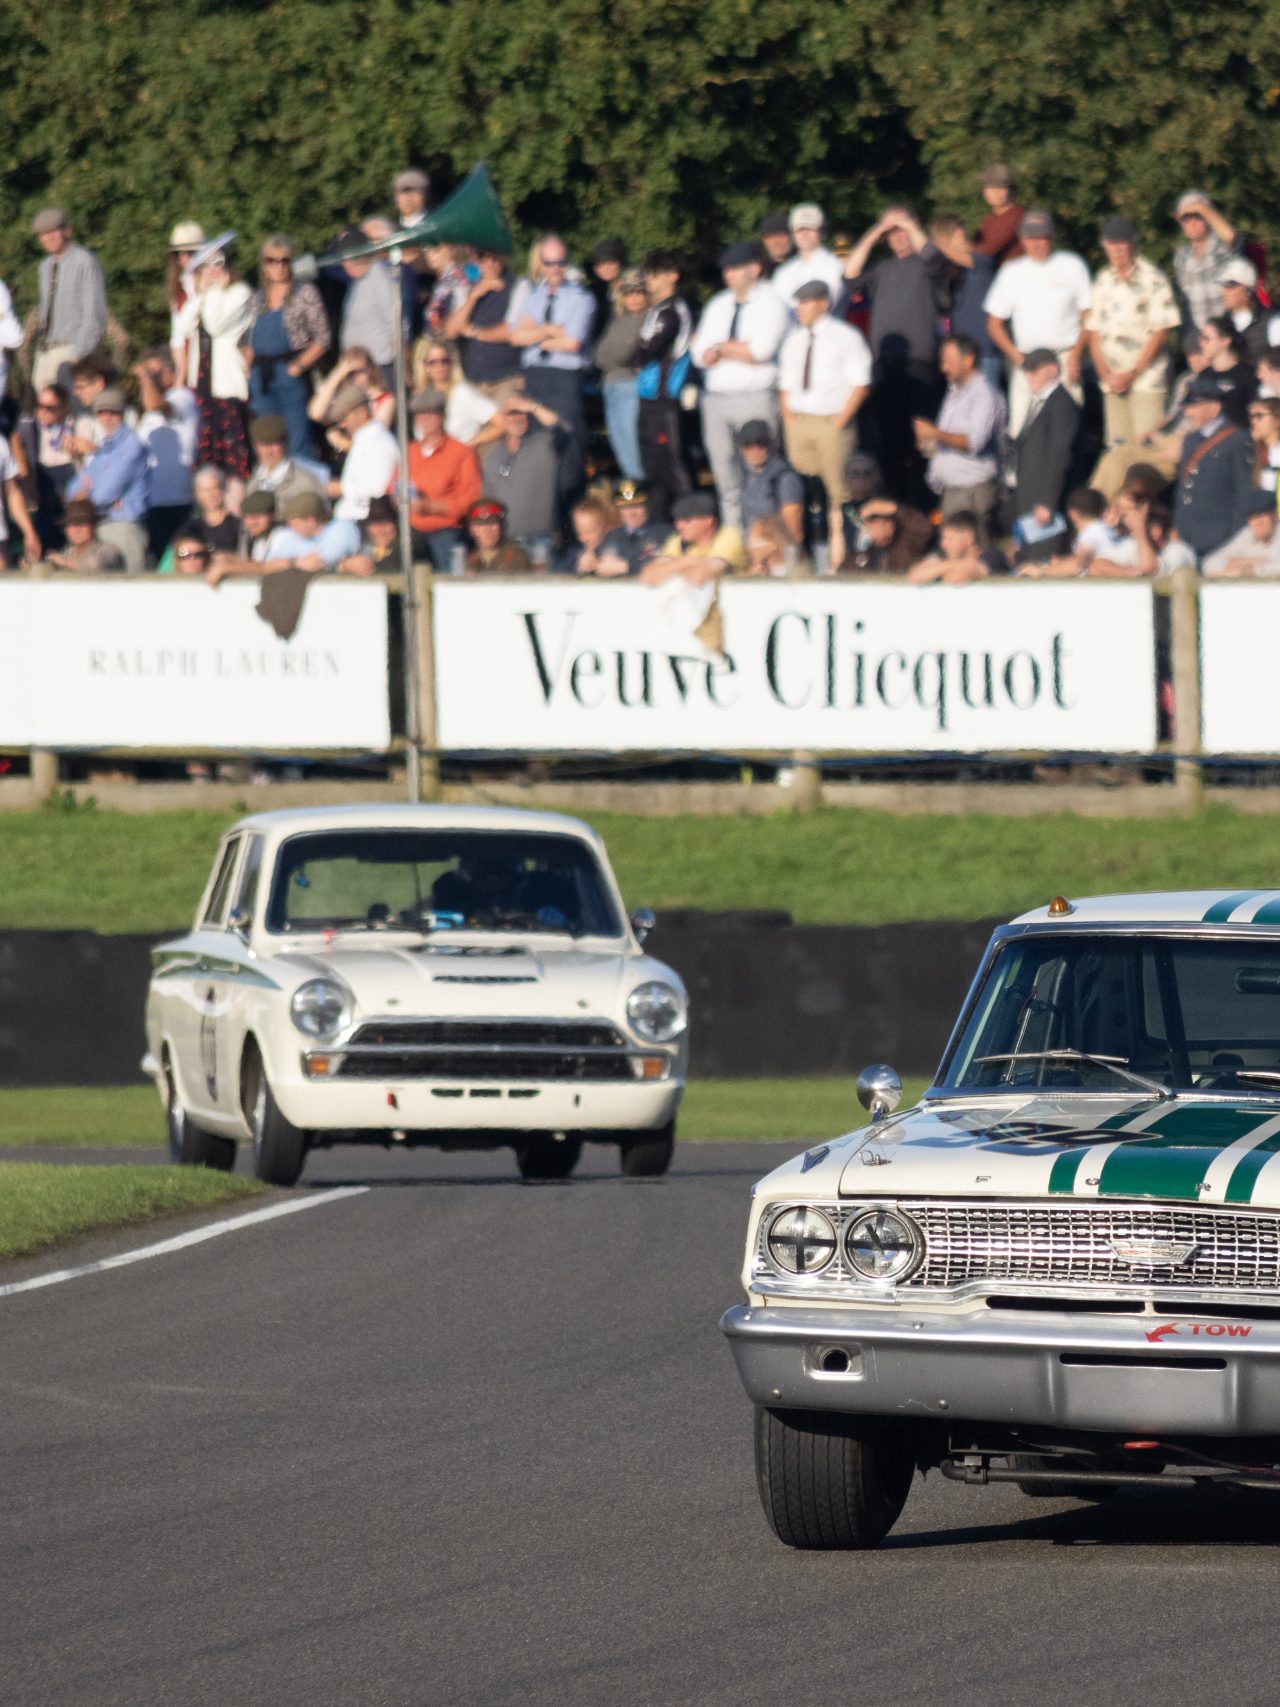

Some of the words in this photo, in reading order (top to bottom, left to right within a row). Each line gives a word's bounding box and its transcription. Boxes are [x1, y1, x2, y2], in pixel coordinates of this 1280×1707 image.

[88, 648, 199, 678] RALPH
[215, 648, 341, 678] LAUREN
[514, 610, 742, 711] Veuve
[762, 610, 1075, 733] Clicquot
[1187, 1323, 1253, 1337] TOW
